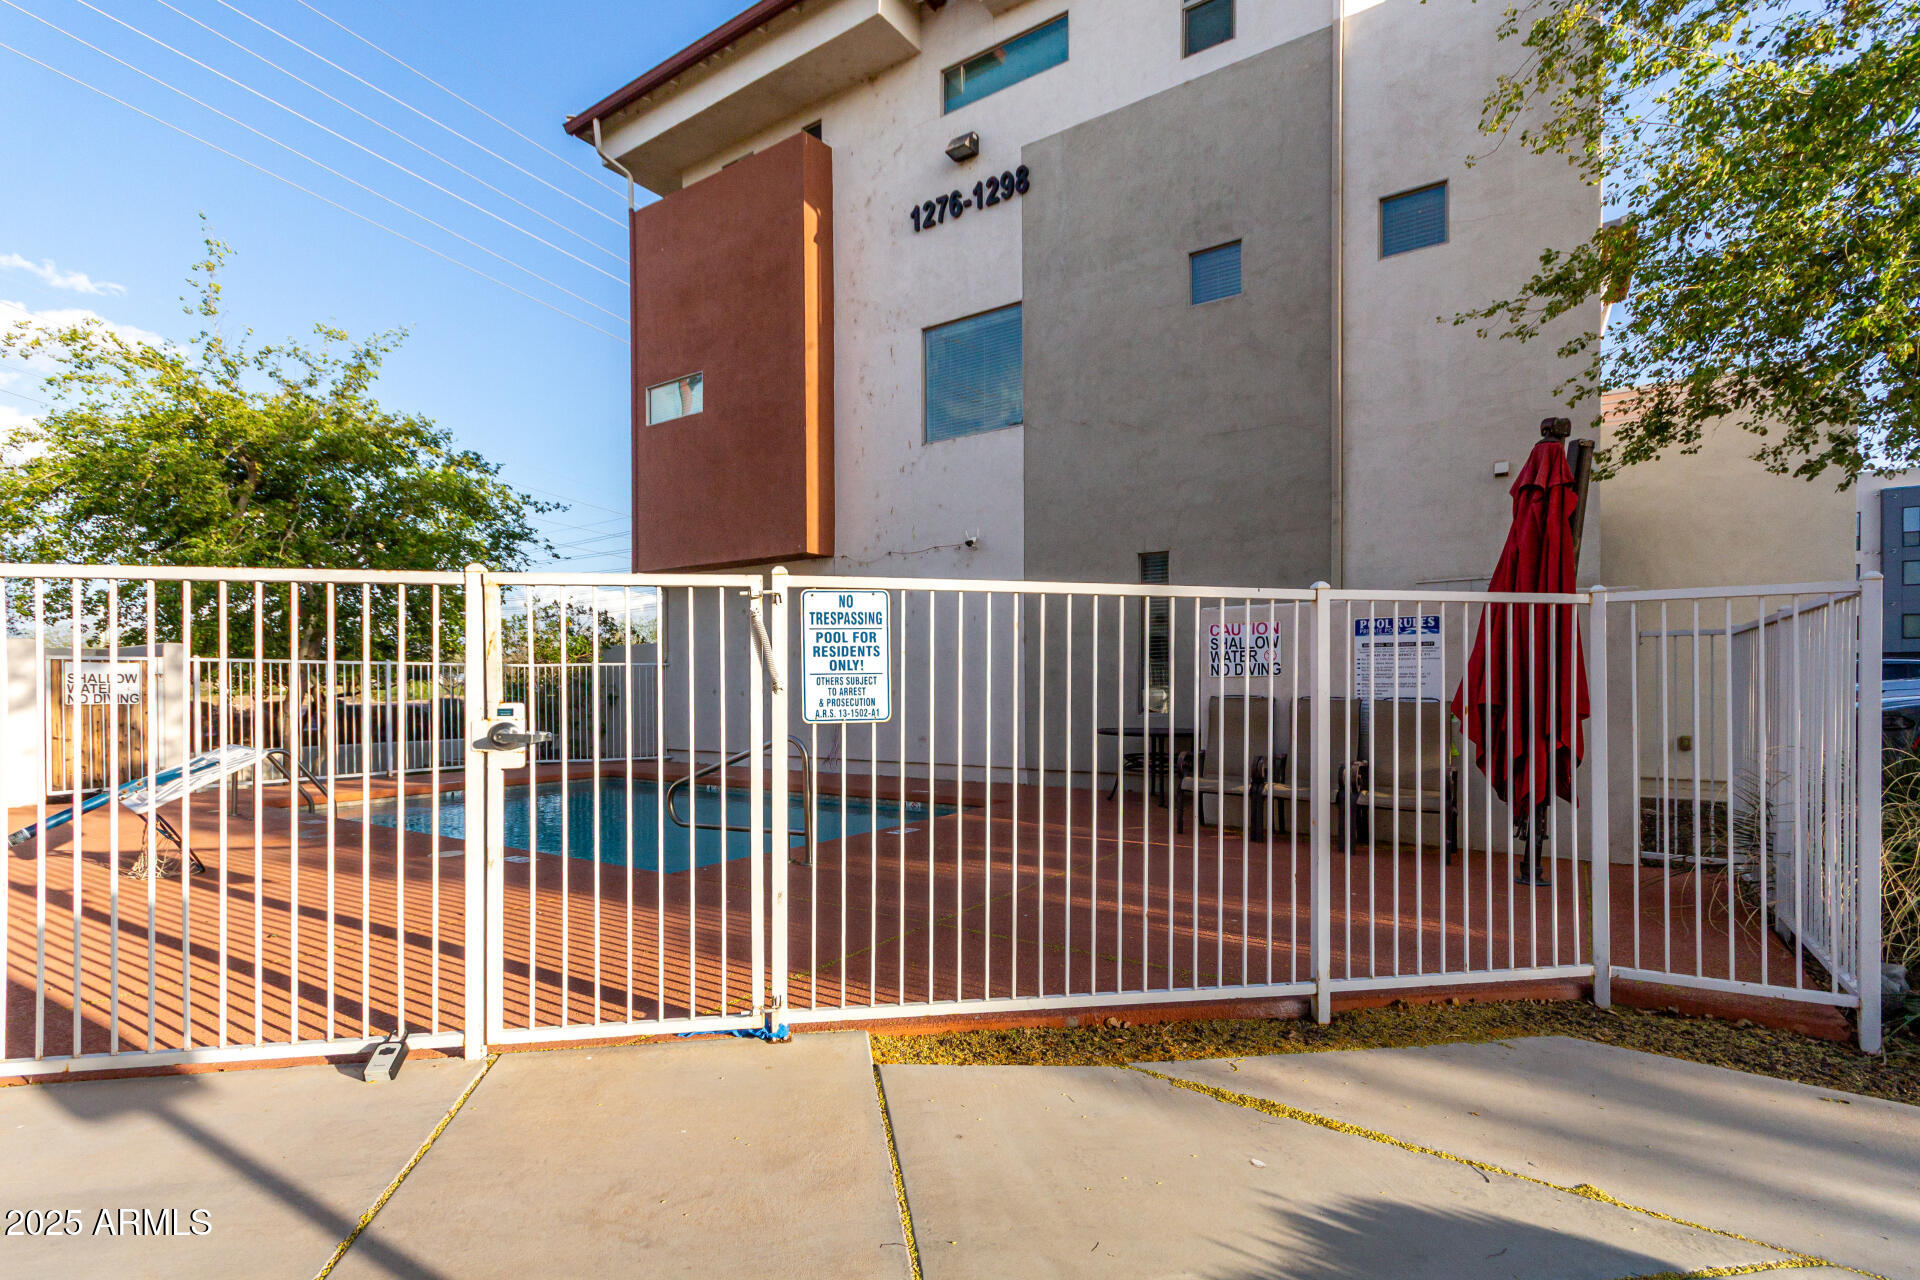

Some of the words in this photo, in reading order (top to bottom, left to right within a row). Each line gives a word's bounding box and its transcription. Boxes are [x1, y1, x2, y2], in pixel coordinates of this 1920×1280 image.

[910, 165, 1030, 233] 1276-1298
[839, 594, 854, 608] NO
[809, 611, 883, 625] TRESPASSING
[1360, 618, 1392, 629] POL
[815, 631, 849, 643] POOL
[853, 631, 877, 643] FOR
[813, 645, 881, 658] RESIDENTS
[829, 659, 864, 671] ONLY!
[1210, 663, 1230, 676] NO
[816, 676, 844, 686] OTHERS
[846, 676, 877, 685] SUBJECT
[828, 687, 837, 696] TO
[839, 686, 866, 696] ARREST
[818, 698, 824, 707] &
[827, 697, 876, 707] PROSECUTION
[815, 709, 836, 718] A.R.S.
[839, 708, 880, 718] 13-1502-A1
